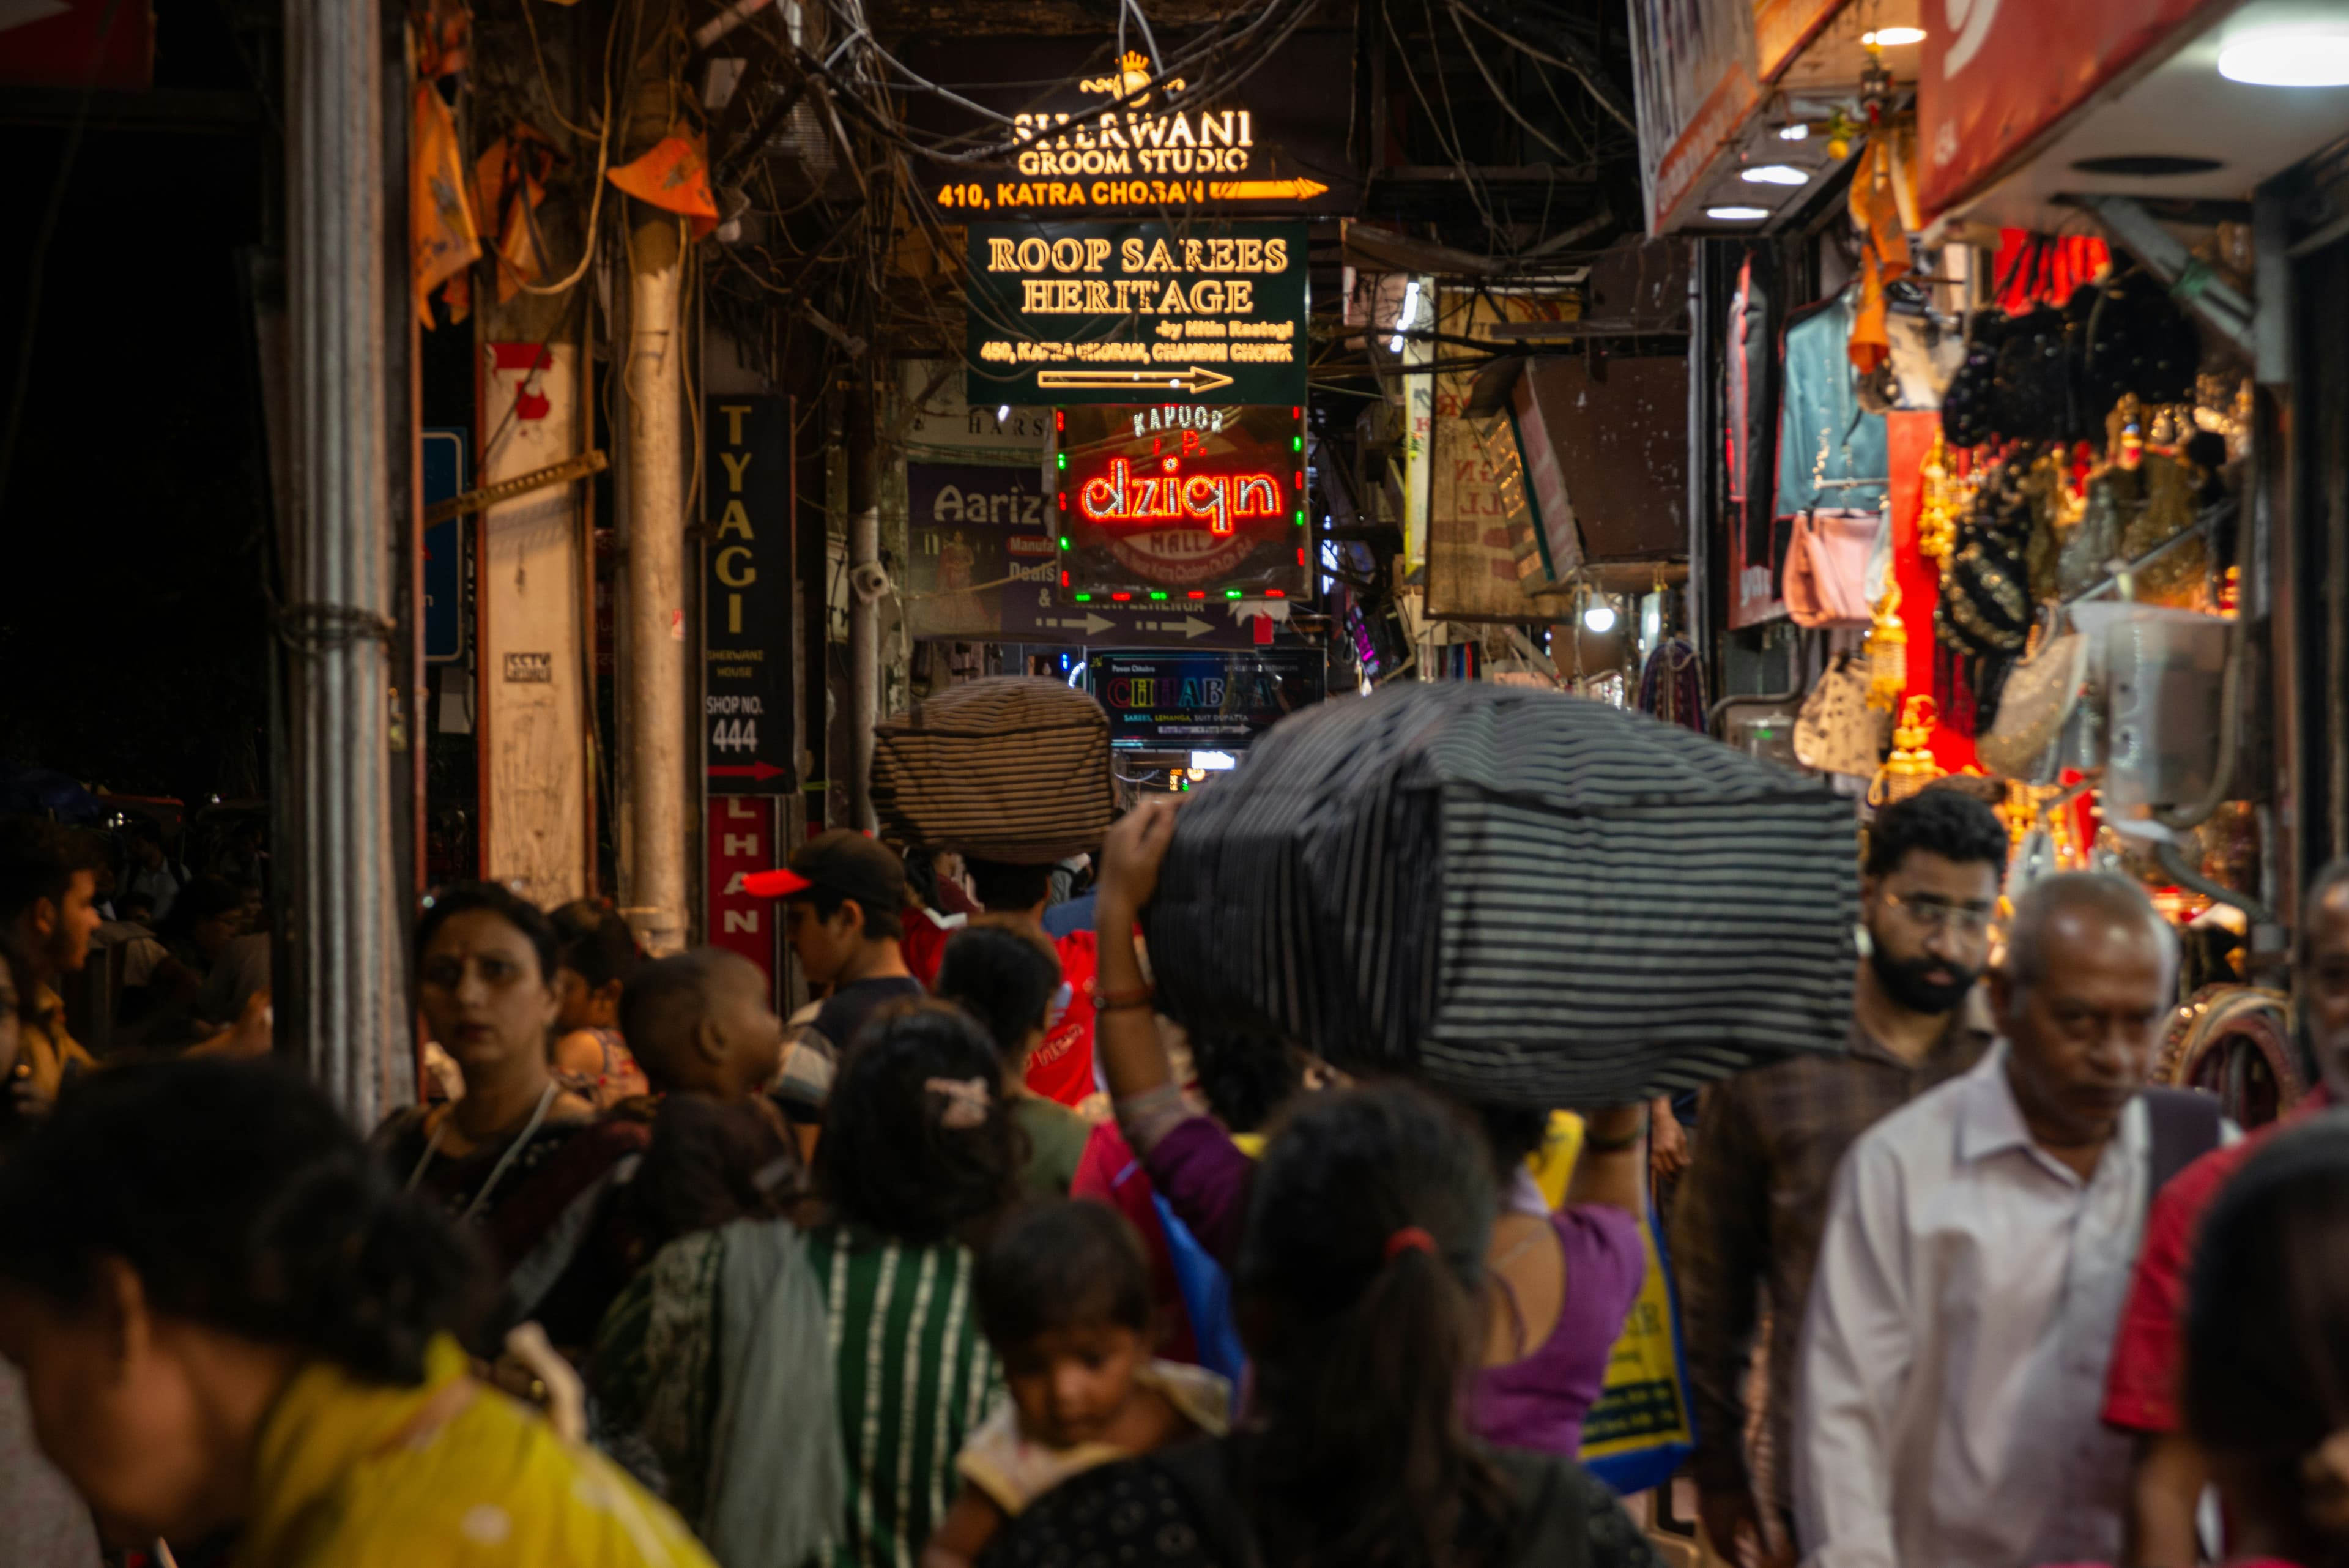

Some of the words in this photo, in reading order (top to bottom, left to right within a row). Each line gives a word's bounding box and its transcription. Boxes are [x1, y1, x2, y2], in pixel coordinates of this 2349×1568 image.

[1012, 111, 1253, 150] SHERWANI
[1018, 149, 1132, 175] GROOM
[1140, 148, 1248, 173] STUDIO
[938, 184, 990, 209] 410,
[997, 183, 1086, 206] KATRA
[1091, 181, 1204, 206] CHOBAN
[987, 237, 1111, 273] ROOP
[1121, 237, 1288, 273] SAREES
[1021, 279, 1253, 314] HERITAGE
[1184, 321, 1226, 338] Nitin
[1229, 321, 1294, 340] Rastogi
[980, 341, 1017, 365] 450,
[1152, 343, 1228, 362] CHANDNI
[1230, 343, 1293, 362] CHOWK
[933, 484, 1041, 525] Aariz
[714, 406, 757, 634] TYAGI
[1010, 562, 1056, 582] Deals
[1039, 587, 1052, 608] &
[716, 666, 753, 678] HOUSE
[707, 695, 740, 715] SHOP
[741, 695, 764, 715] NO.
[712, 718, 759, 754] 444
